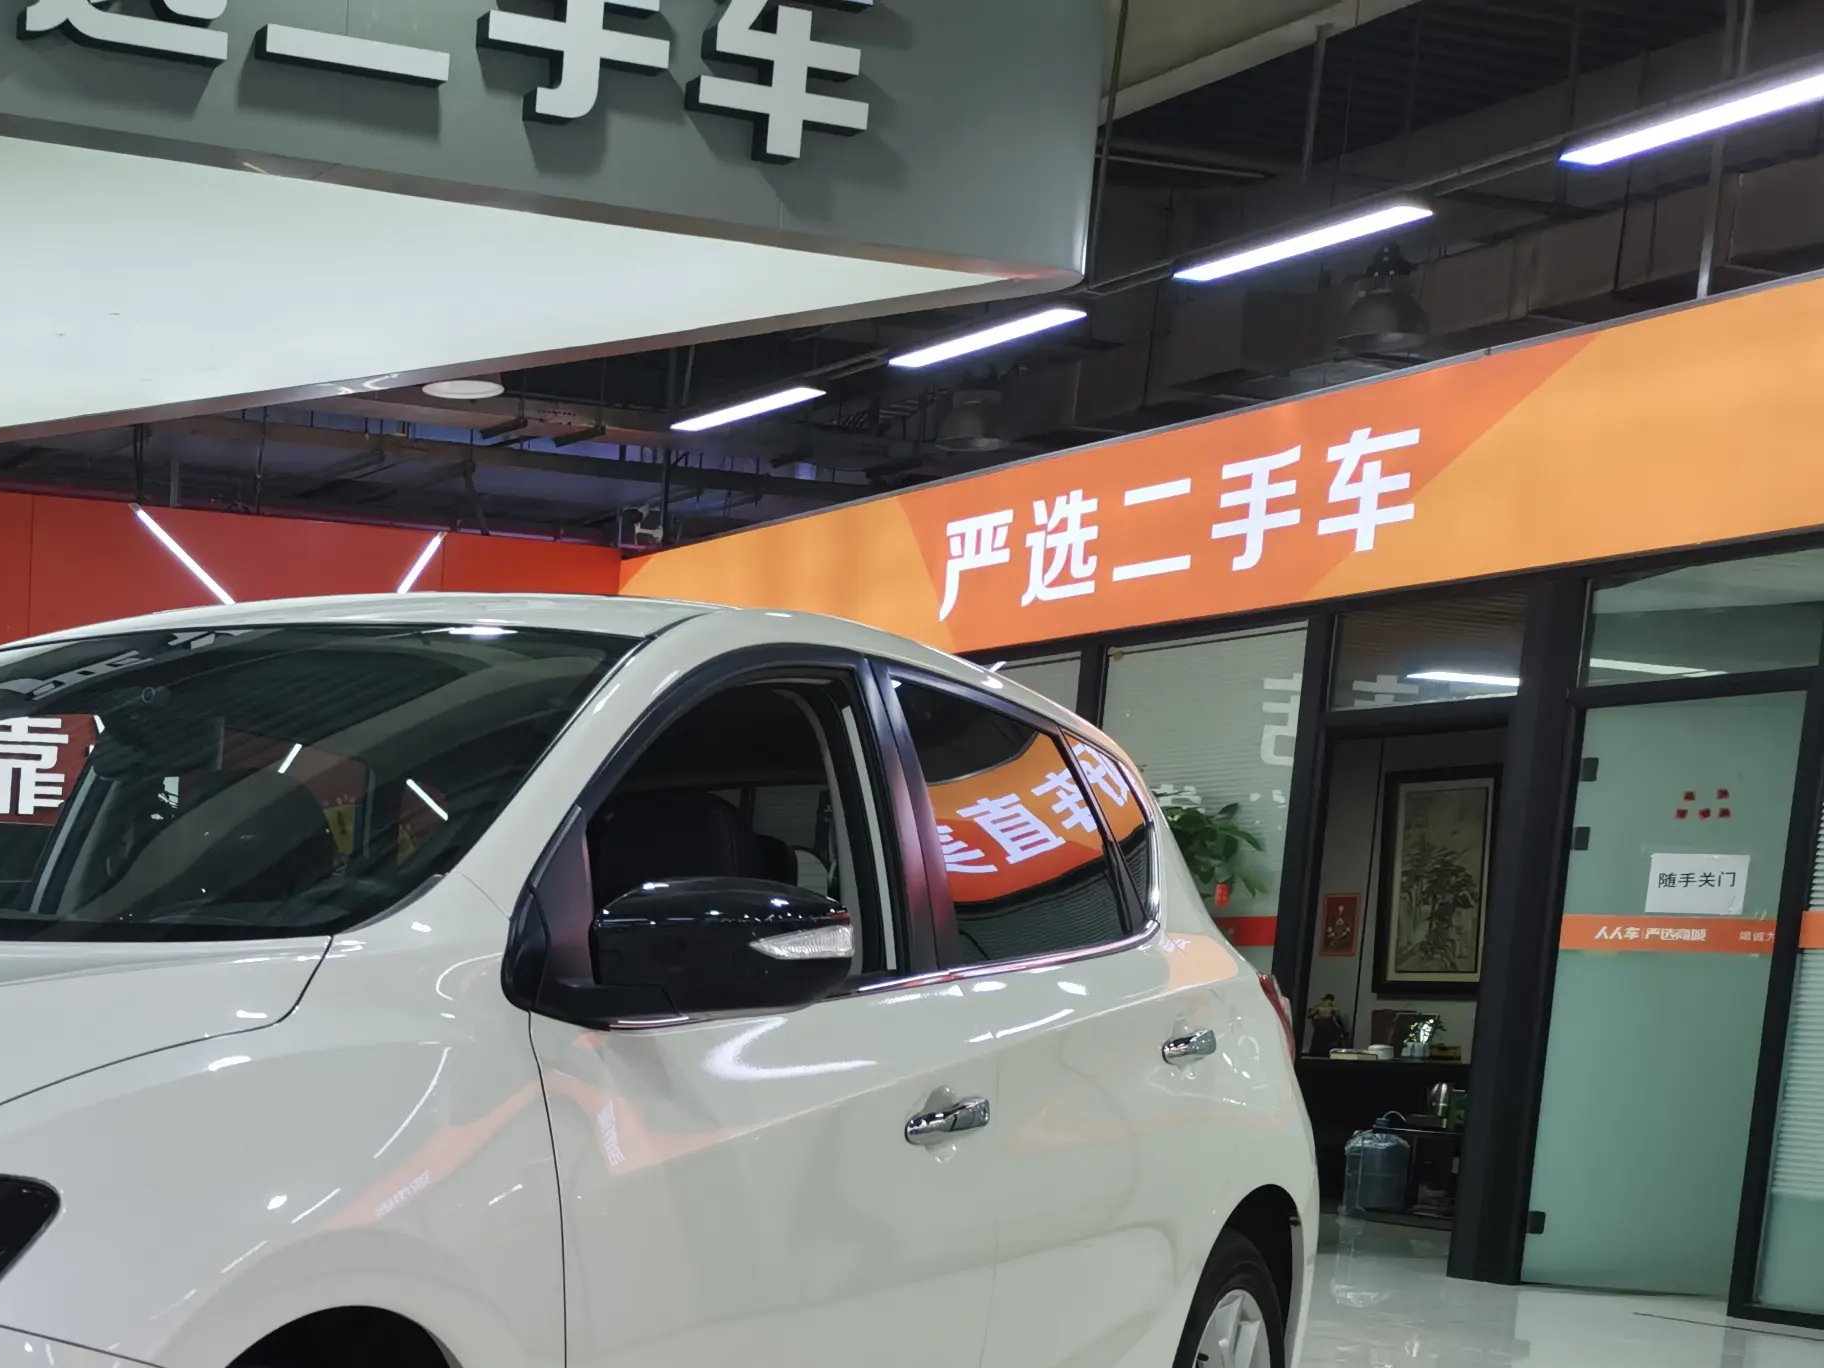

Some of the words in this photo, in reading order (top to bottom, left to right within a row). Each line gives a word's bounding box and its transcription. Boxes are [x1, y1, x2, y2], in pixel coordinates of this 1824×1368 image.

[938, 427, 1421, 622] 严选二手车
[1658, 871, 1737, 888] 随手关门
[1594, 925, 1641, 940] 人人车
